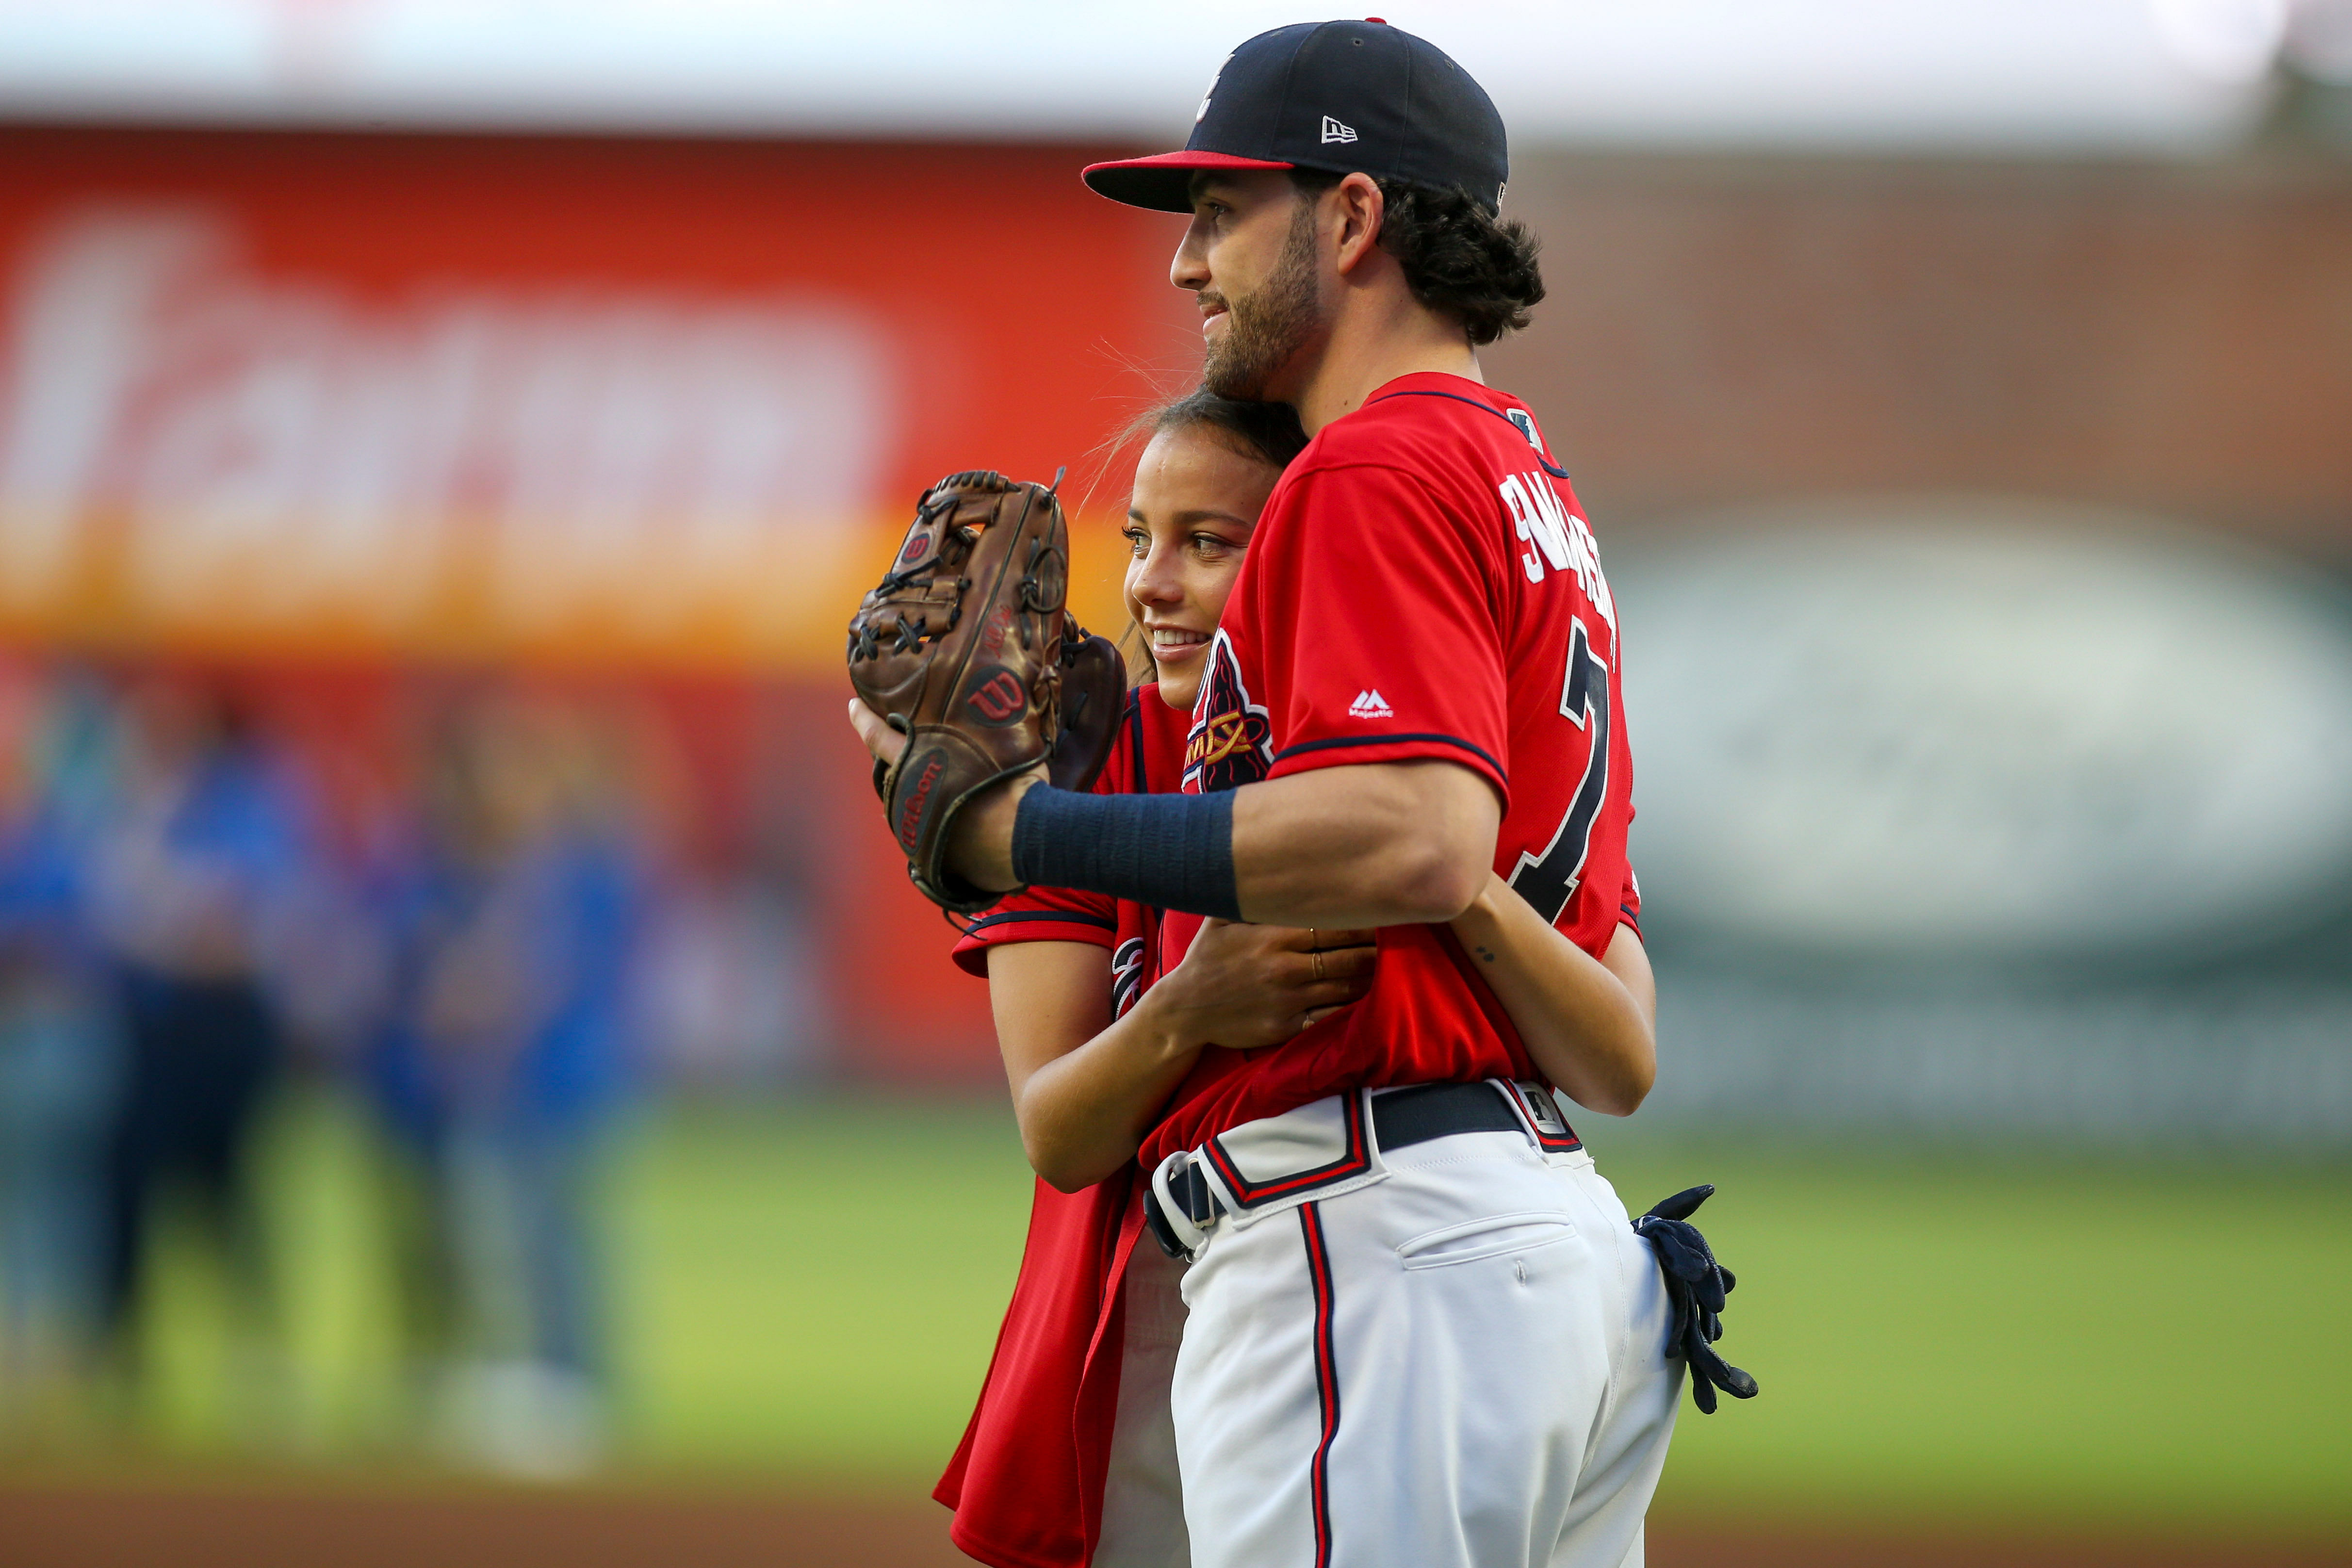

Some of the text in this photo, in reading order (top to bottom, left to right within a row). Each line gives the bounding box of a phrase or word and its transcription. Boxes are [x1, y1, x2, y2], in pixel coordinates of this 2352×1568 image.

[1348, 707, 1394, 719] Majestic
[901, 761, 943, 849] Wilson
[1506, 613, 1610, 927] 7
